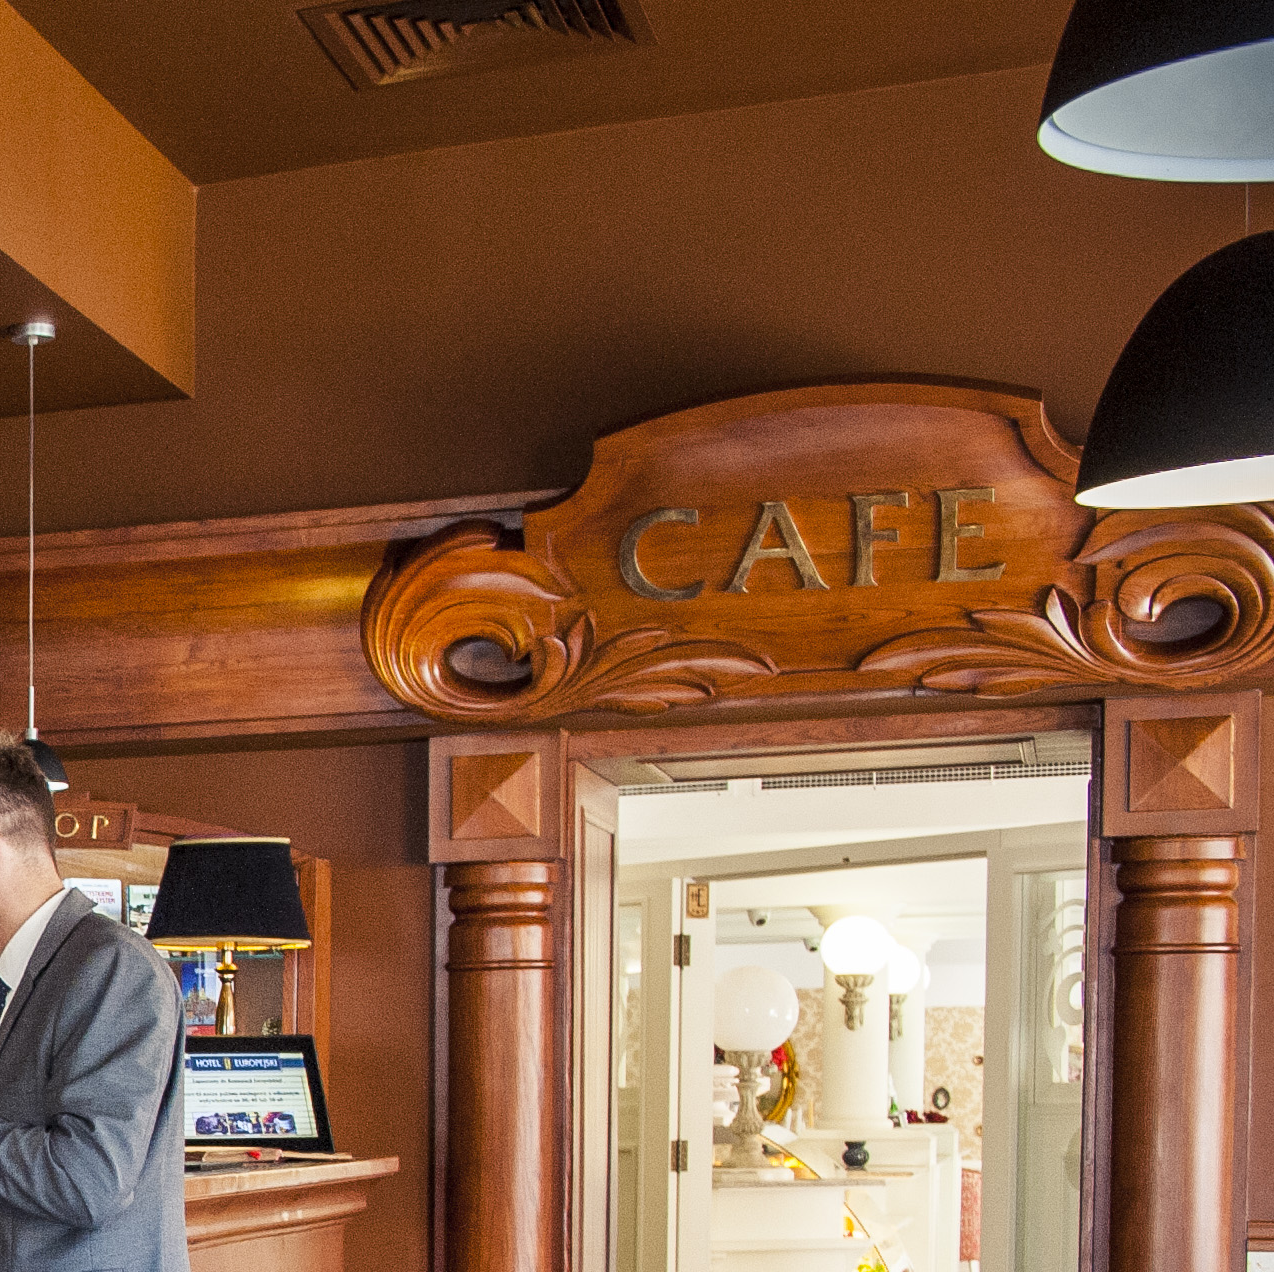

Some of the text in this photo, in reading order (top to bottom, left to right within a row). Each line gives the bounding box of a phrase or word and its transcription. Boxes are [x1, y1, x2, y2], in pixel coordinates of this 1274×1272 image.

[618, 486, 1007, 601] CAFE
[54, 812, 110, 840] OP
[195, 1058, 223, 1068] HOTEL
